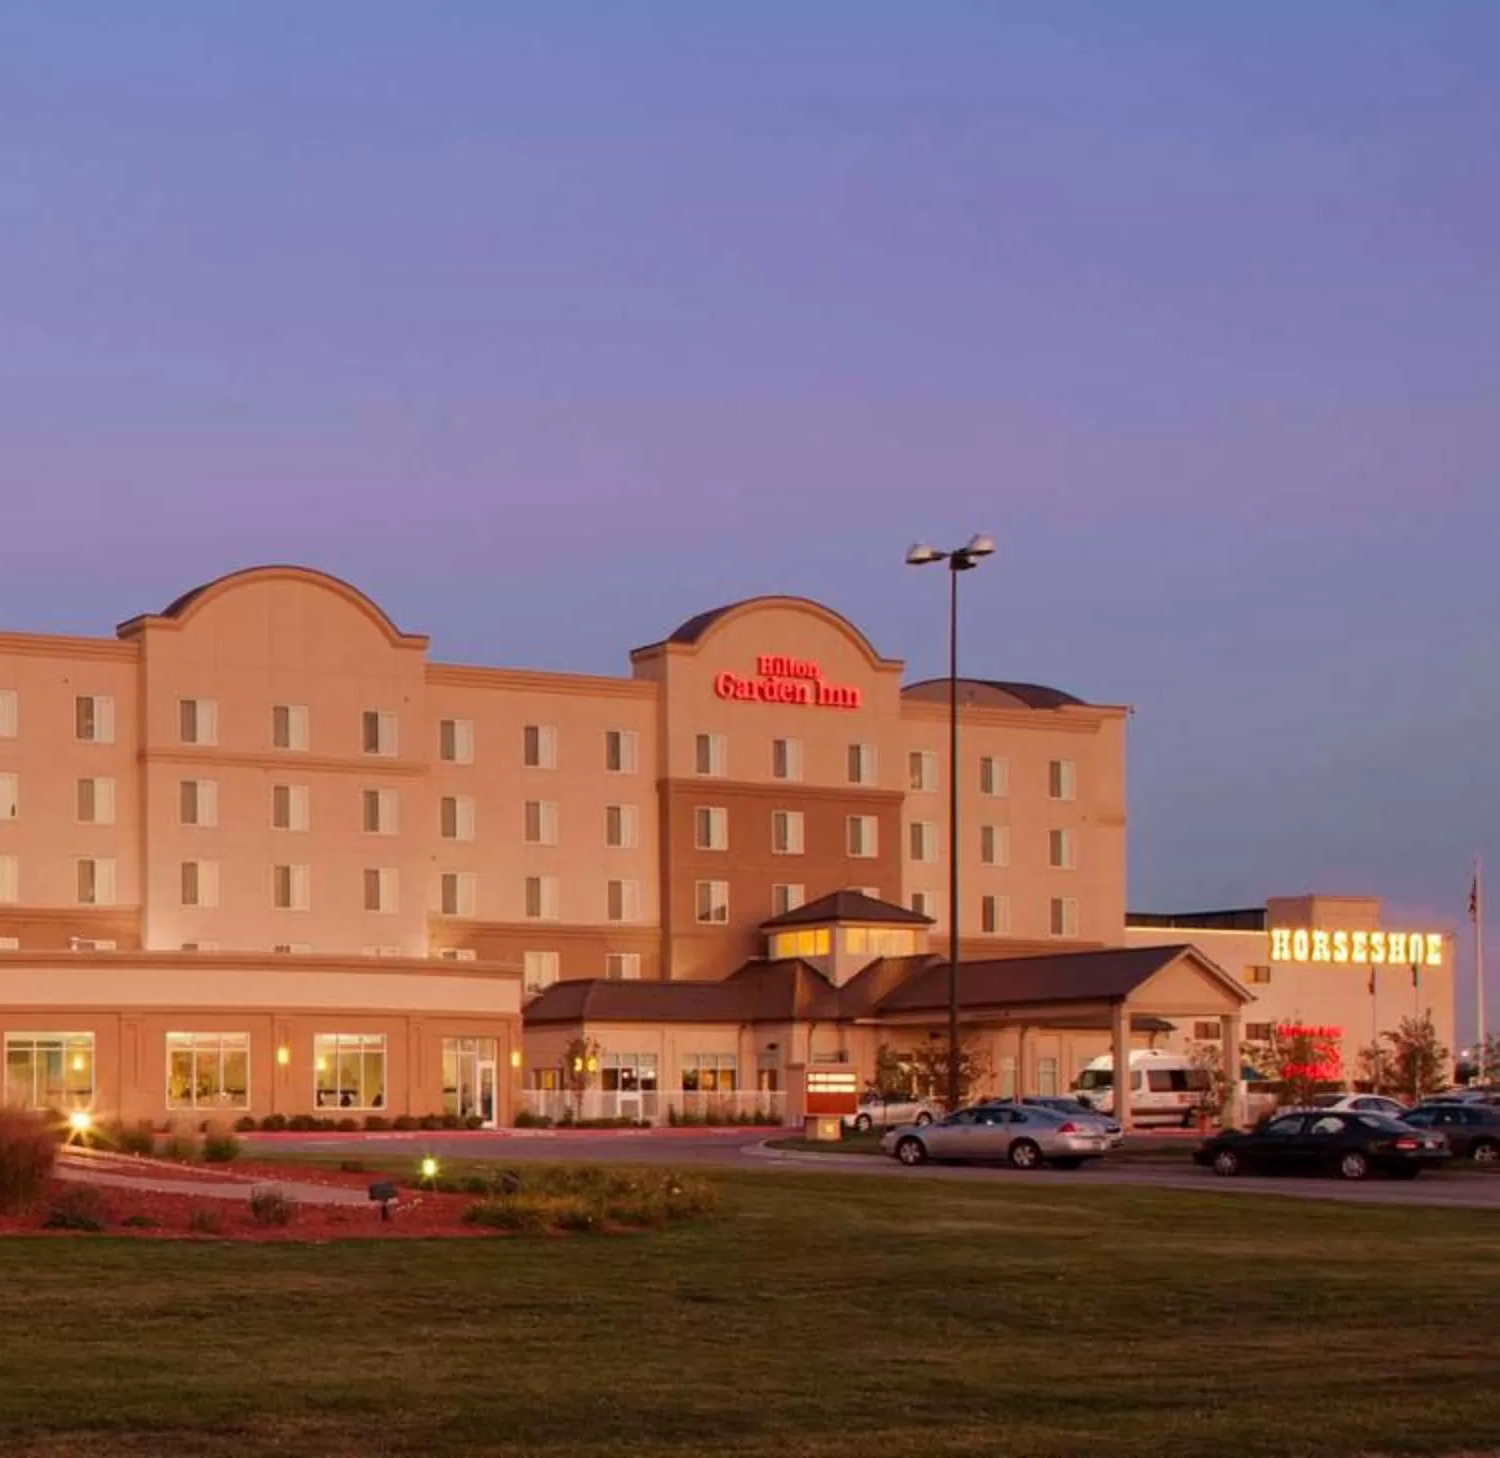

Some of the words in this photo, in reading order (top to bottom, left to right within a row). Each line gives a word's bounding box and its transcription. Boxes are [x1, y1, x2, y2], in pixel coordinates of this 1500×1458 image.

[757, 655, 820, 679] Hilton
[715, 671, 809, 704] Garden
[815, 679, 861, 708] Inn
[1270, 927, 1442, 965] HORSESHOE
